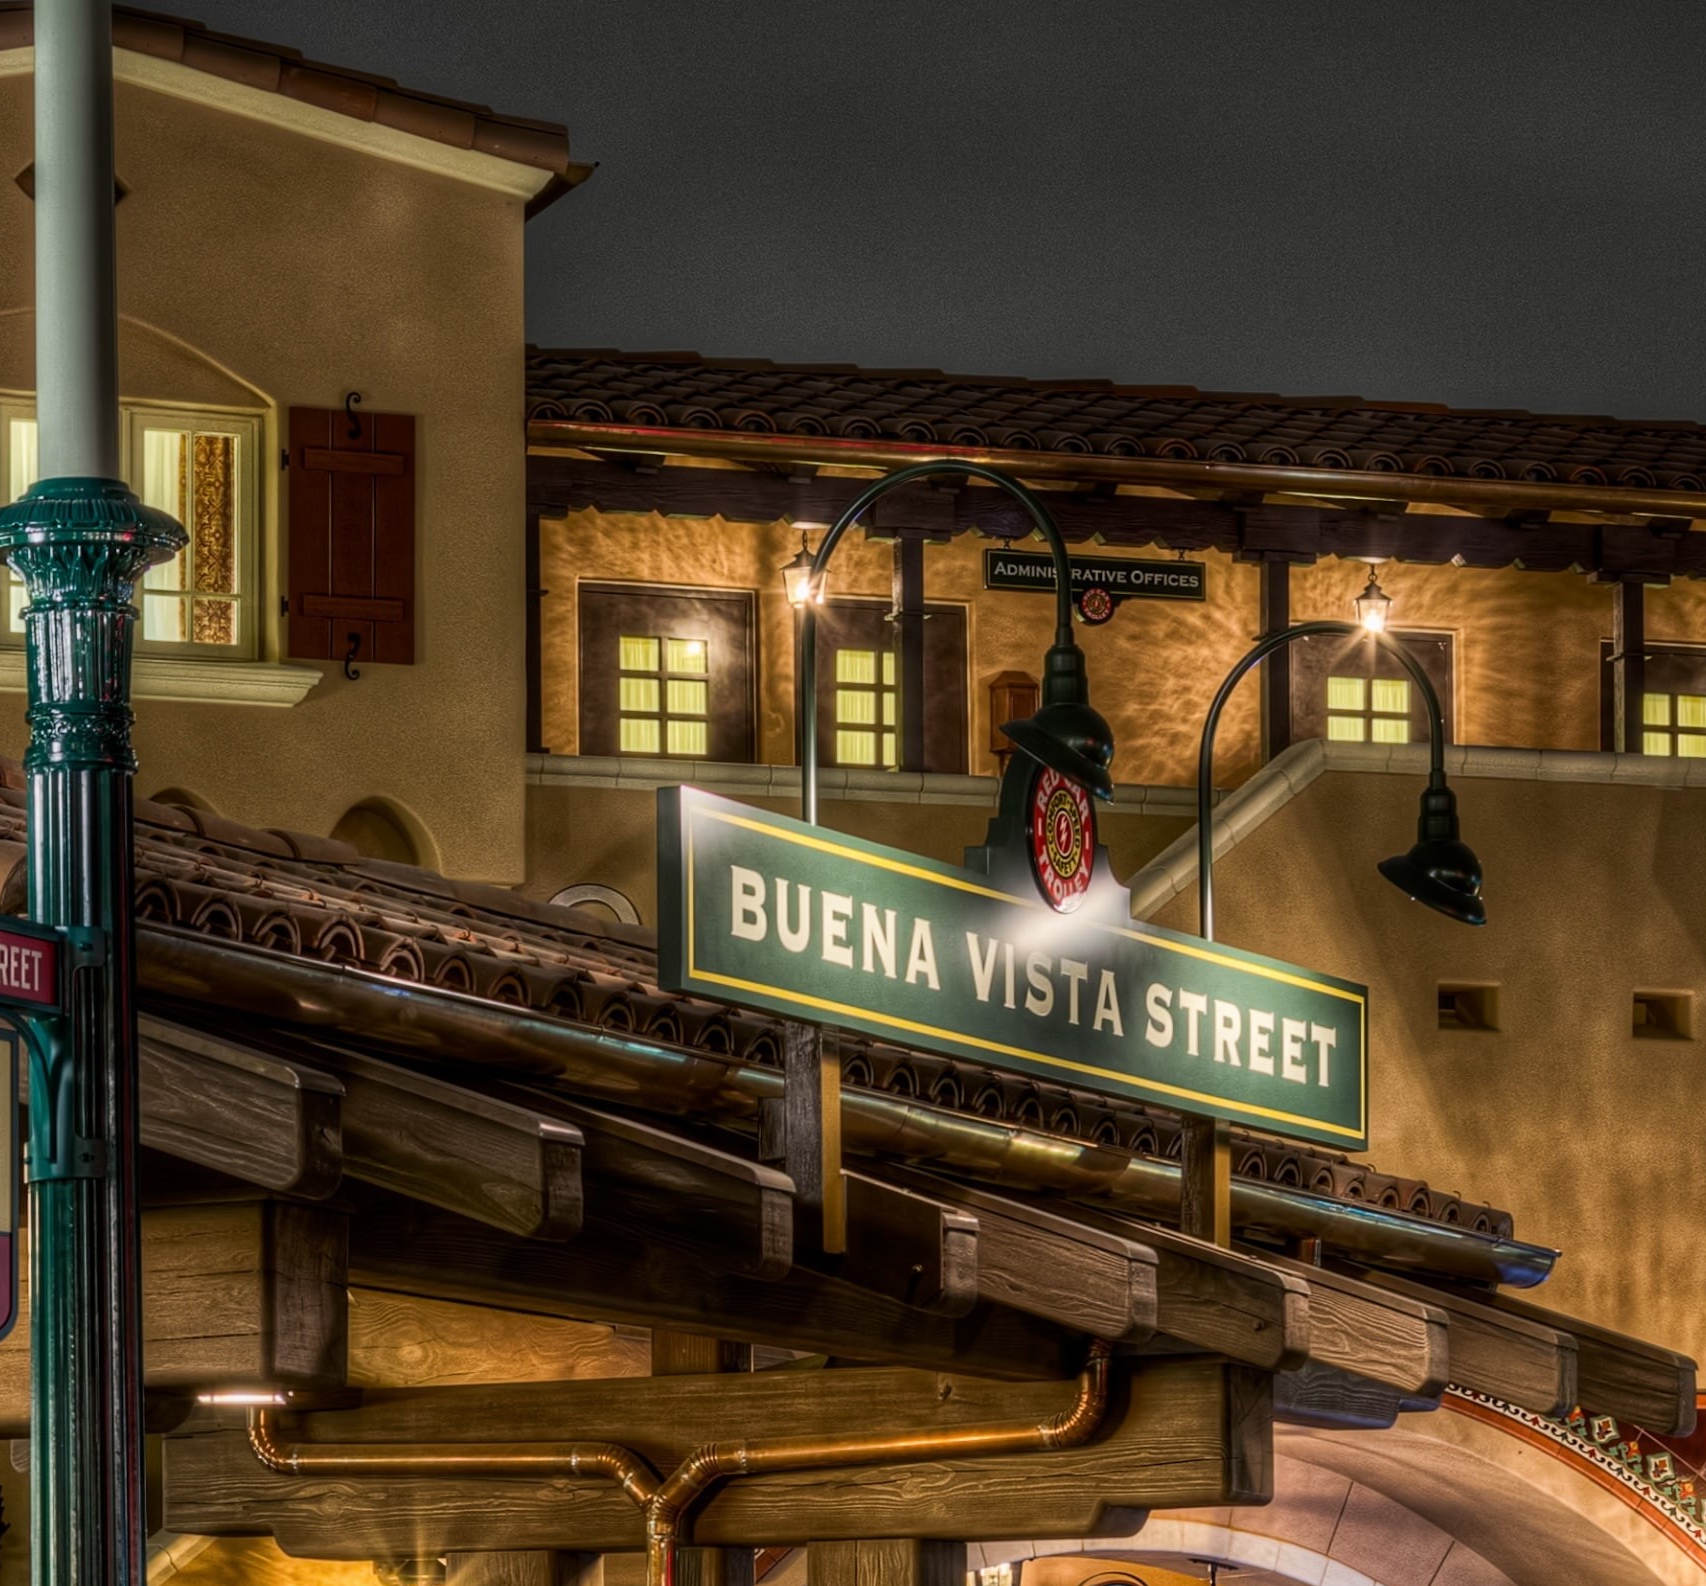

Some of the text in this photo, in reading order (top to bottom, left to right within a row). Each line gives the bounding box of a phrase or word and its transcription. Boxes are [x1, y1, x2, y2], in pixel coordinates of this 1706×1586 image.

[994, 561, 1128, 584] ADMINISRATIVE
[730, 864, 1338, 1088] BUENA VISTA STREET
